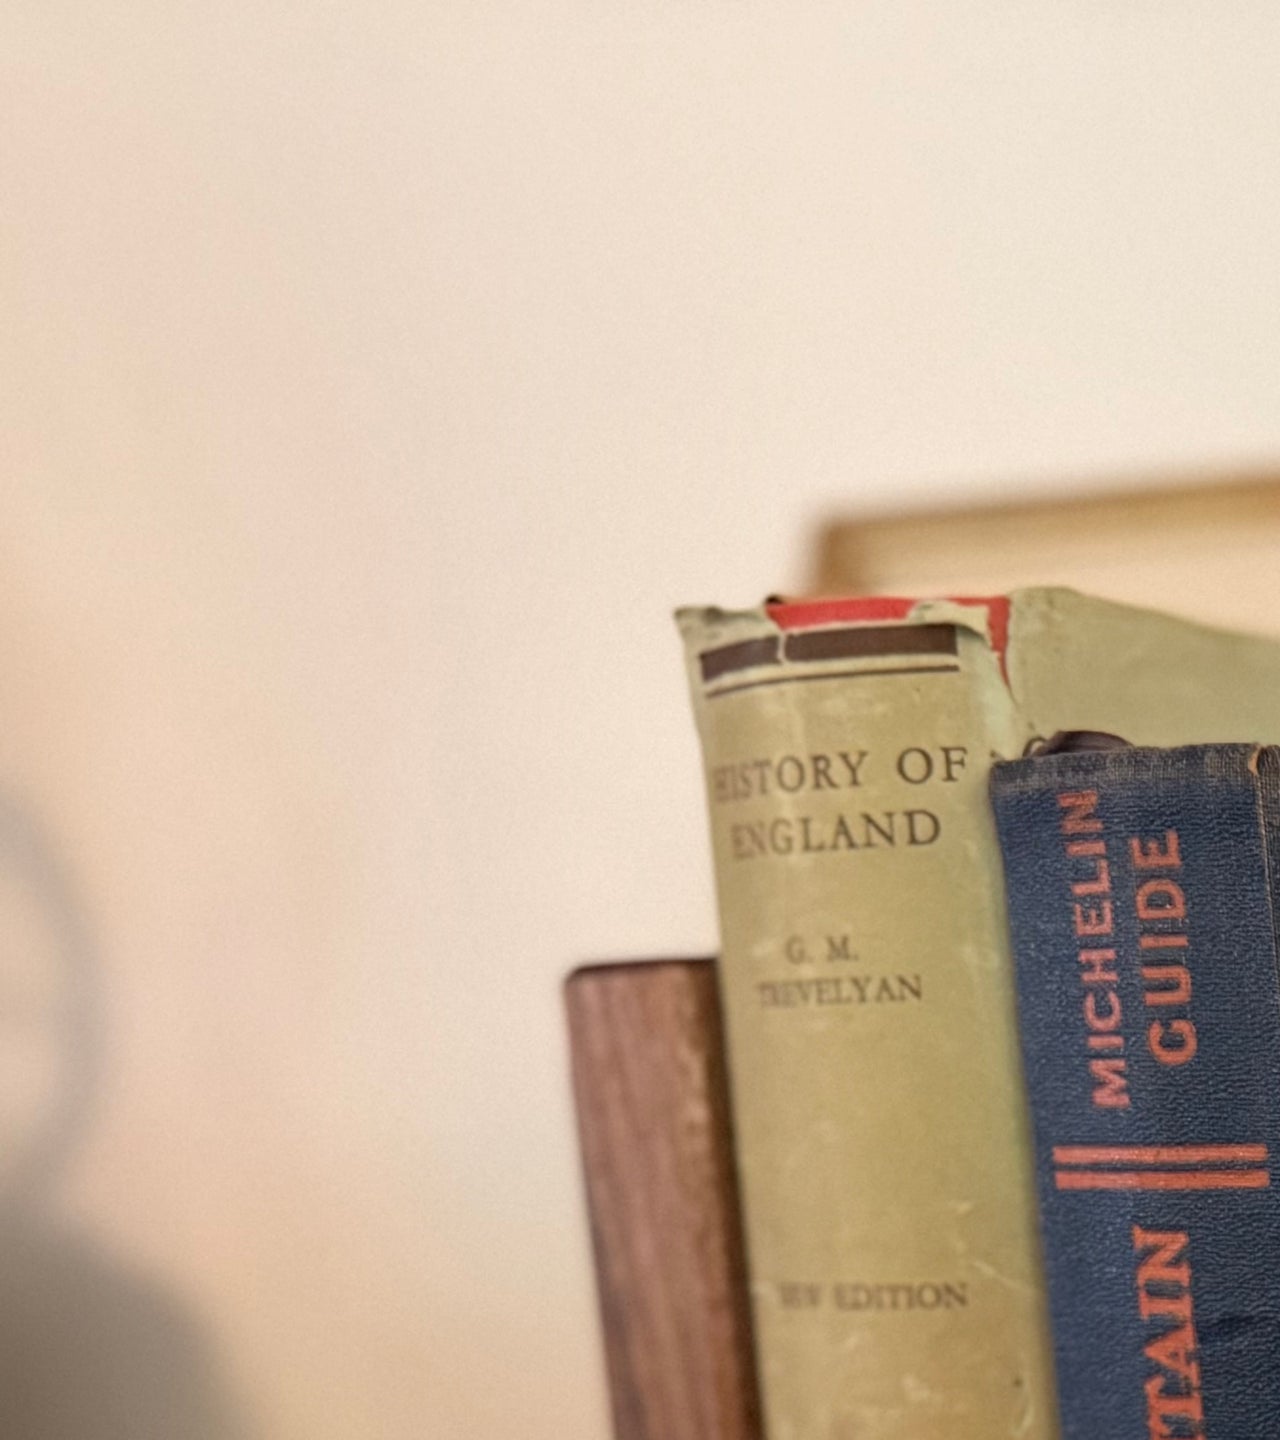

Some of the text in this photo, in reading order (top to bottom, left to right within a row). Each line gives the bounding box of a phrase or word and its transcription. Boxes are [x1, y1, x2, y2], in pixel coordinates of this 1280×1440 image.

[732, 810, 941, 860] ENGLAND
[896, 746, 968, 784] OF
[1058, 790, 1130, 1109] MICHELIN
[1130, 829, 1197, 1066] GUIDE
